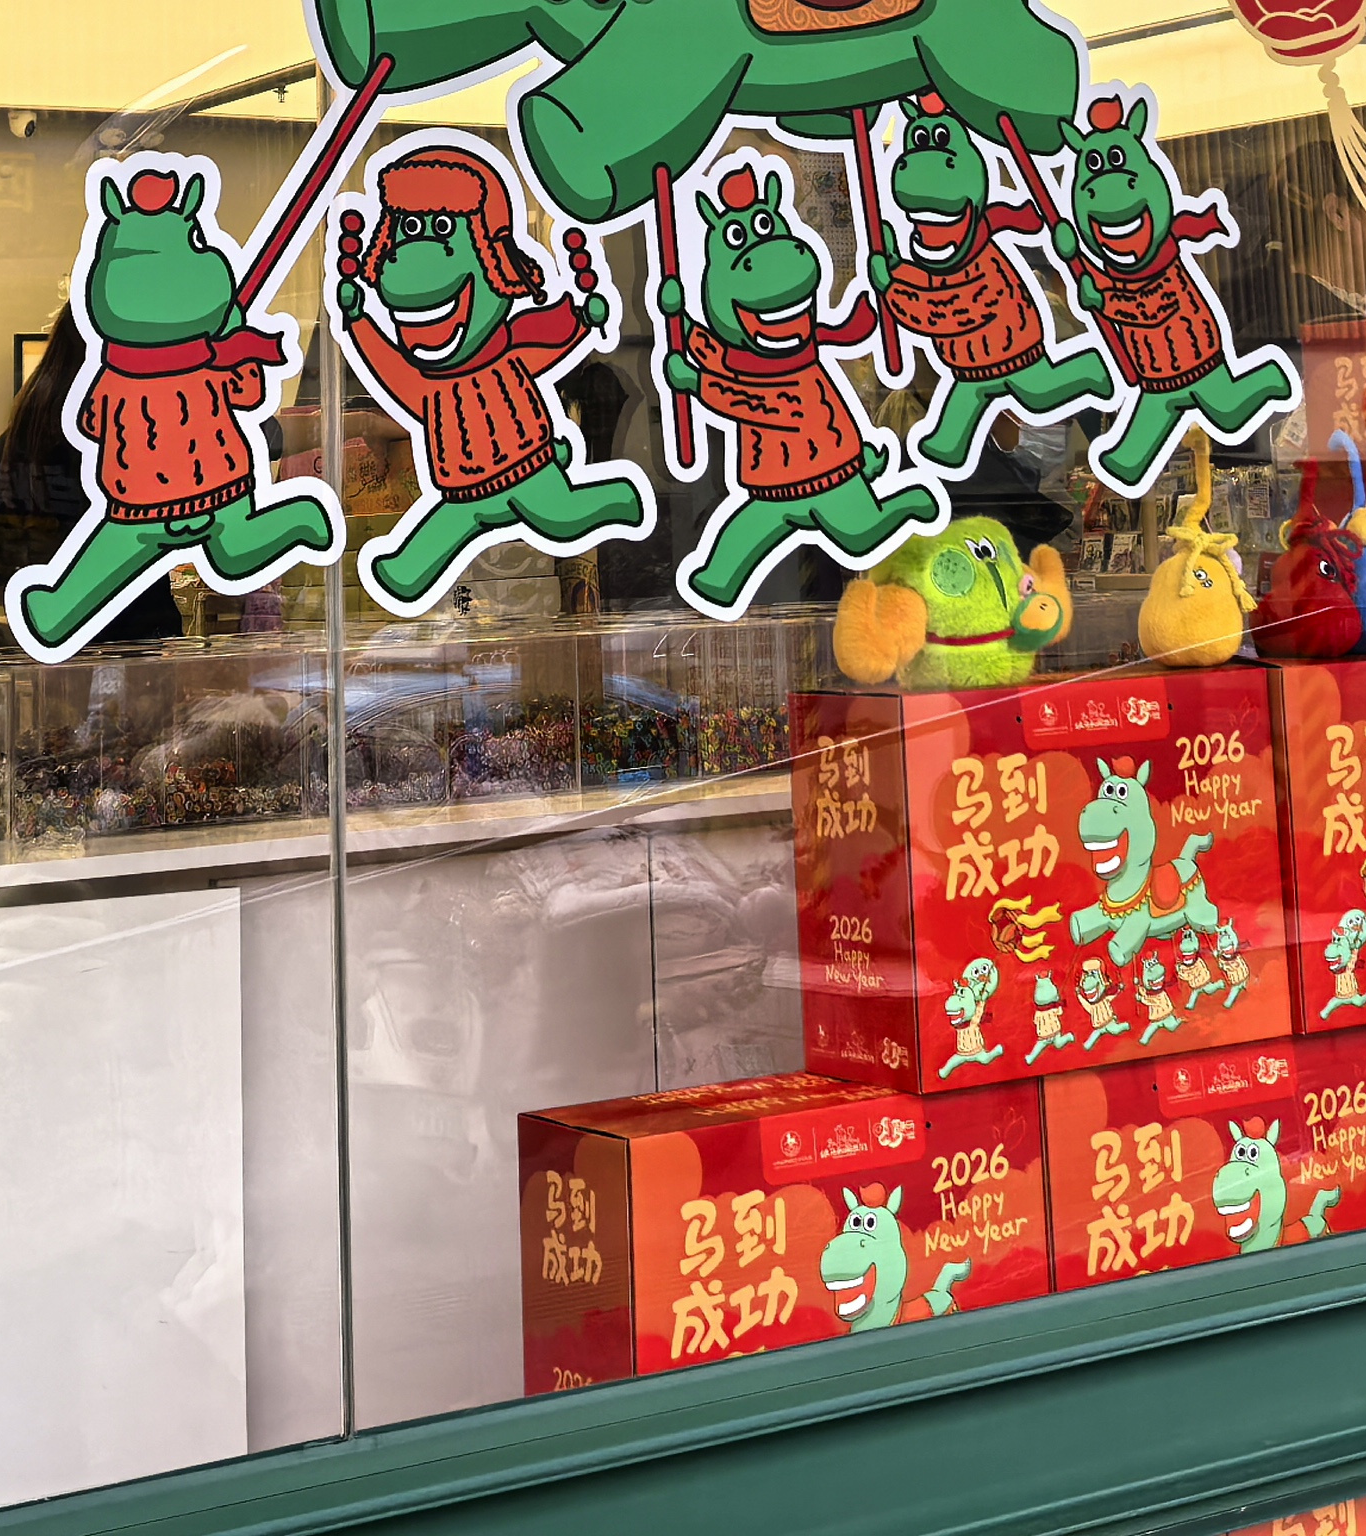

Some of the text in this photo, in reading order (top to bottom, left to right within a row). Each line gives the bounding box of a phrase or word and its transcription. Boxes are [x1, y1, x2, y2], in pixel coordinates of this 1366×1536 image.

[817, 735, 870, 785] 马到
[1176, 729, 1246, 771] 2026
[950, 753, 1048, 829] 马到
[1184, 770, 1241, 802] Happy
[816, 792, 878, 839] 成功
[1171, 796, 1263, 830] New Year
[945, 823, 1060, 901] 成功
[830, 914, 873, 944] 2026
[1312, 1121, 1366, 1152] Happy
[931, 1142, 1010, 1195] 2026
[1090, 1121, 1183, 1203] 马到
[1299, 1157, 1340, 1185] New
[545, 1170, 597, 1233] 马到
[939, 1191, 1005, 1221] Happy
[680, 1189, 787, 1279] 马到
[924, 1215, 1029, 1258] New Year
[1086, 1192, 1196, 1277] 成功
[541, 1231, 604, 1288] 成功
[670, 1266, 798, 1360] 成功
